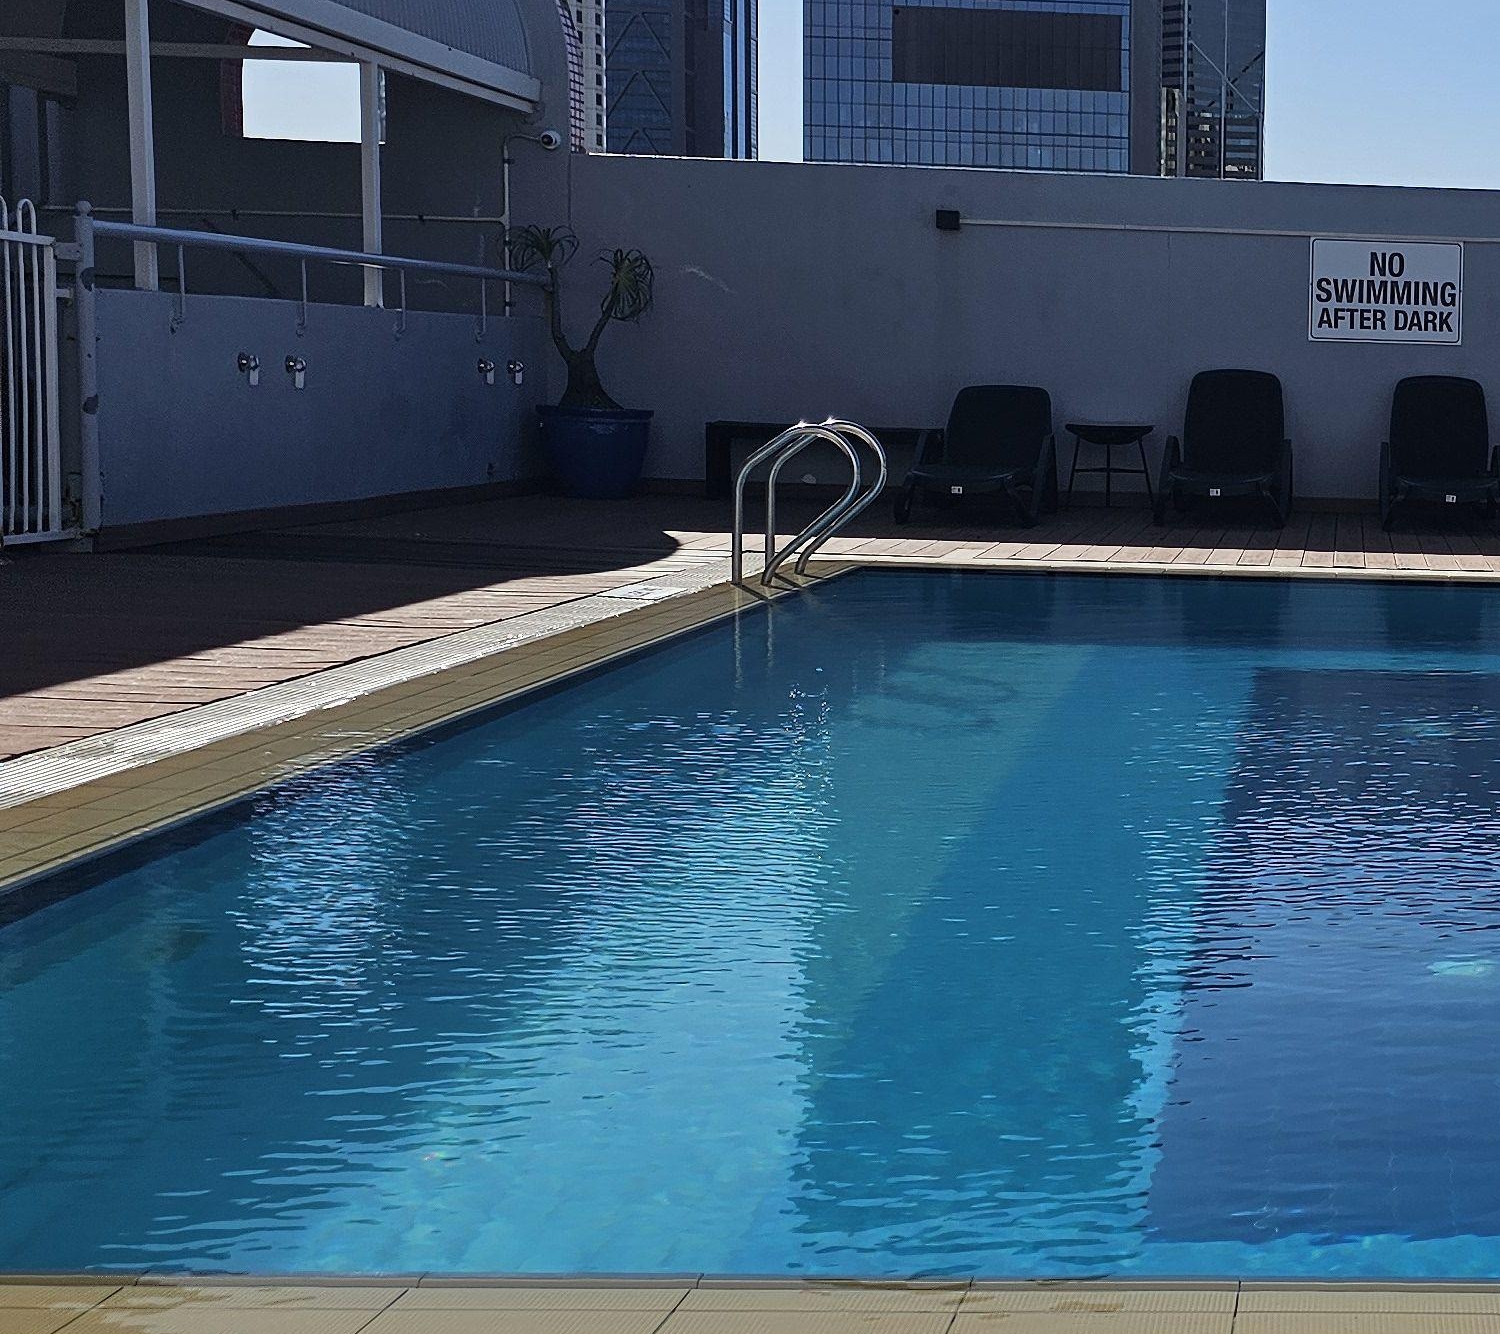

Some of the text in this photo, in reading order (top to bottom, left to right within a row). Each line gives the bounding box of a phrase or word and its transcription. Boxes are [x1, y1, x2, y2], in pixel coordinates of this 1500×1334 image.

[1369, 251, 1405, 277] NO
[1315, 277, 1457, 307] SWIMMING
[1317, 307, 1453, 332] AFTER DARK
